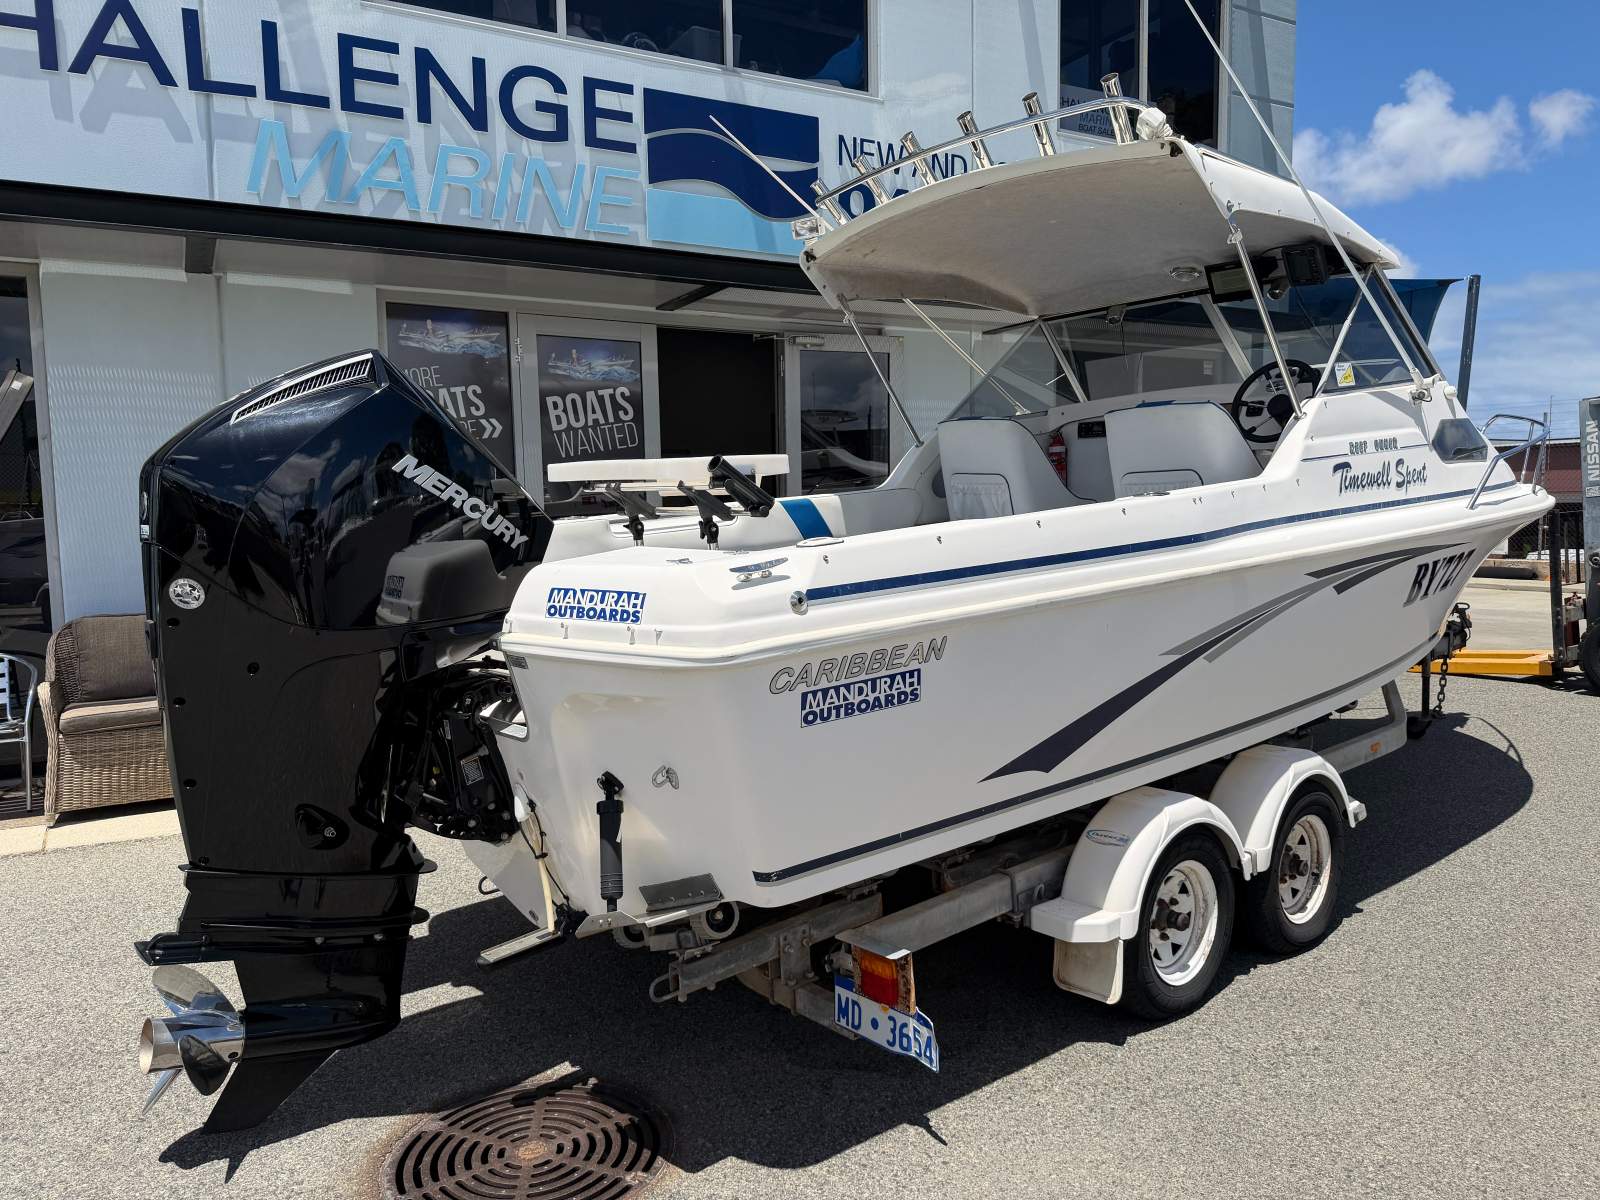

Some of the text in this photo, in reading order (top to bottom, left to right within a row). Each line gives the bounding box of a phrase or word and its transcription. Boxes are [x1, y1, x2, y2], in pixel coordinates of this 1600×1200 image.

[246, 119, 640, 236] MARINE
[546, 386, 635, 431] BOATS
[554, 422, 639, 458] WANTED
[1586, 420, 1600, 481] NISSAN
[1332, 458, 1428, 496] Timewell Spent
[392, 454, 529, 549] MERCURY
[547, 604, 641, 623] OUTBOARDS
[550, 588, 644, 609] MANDURAH
[769, 636, 948, 695] CARIBBEAN
[803, 687, 920, 725] OUTBOARDS
[805, 671, 919, 710] MANDURAH
[837, 993, 935, 1067] MD 3654
